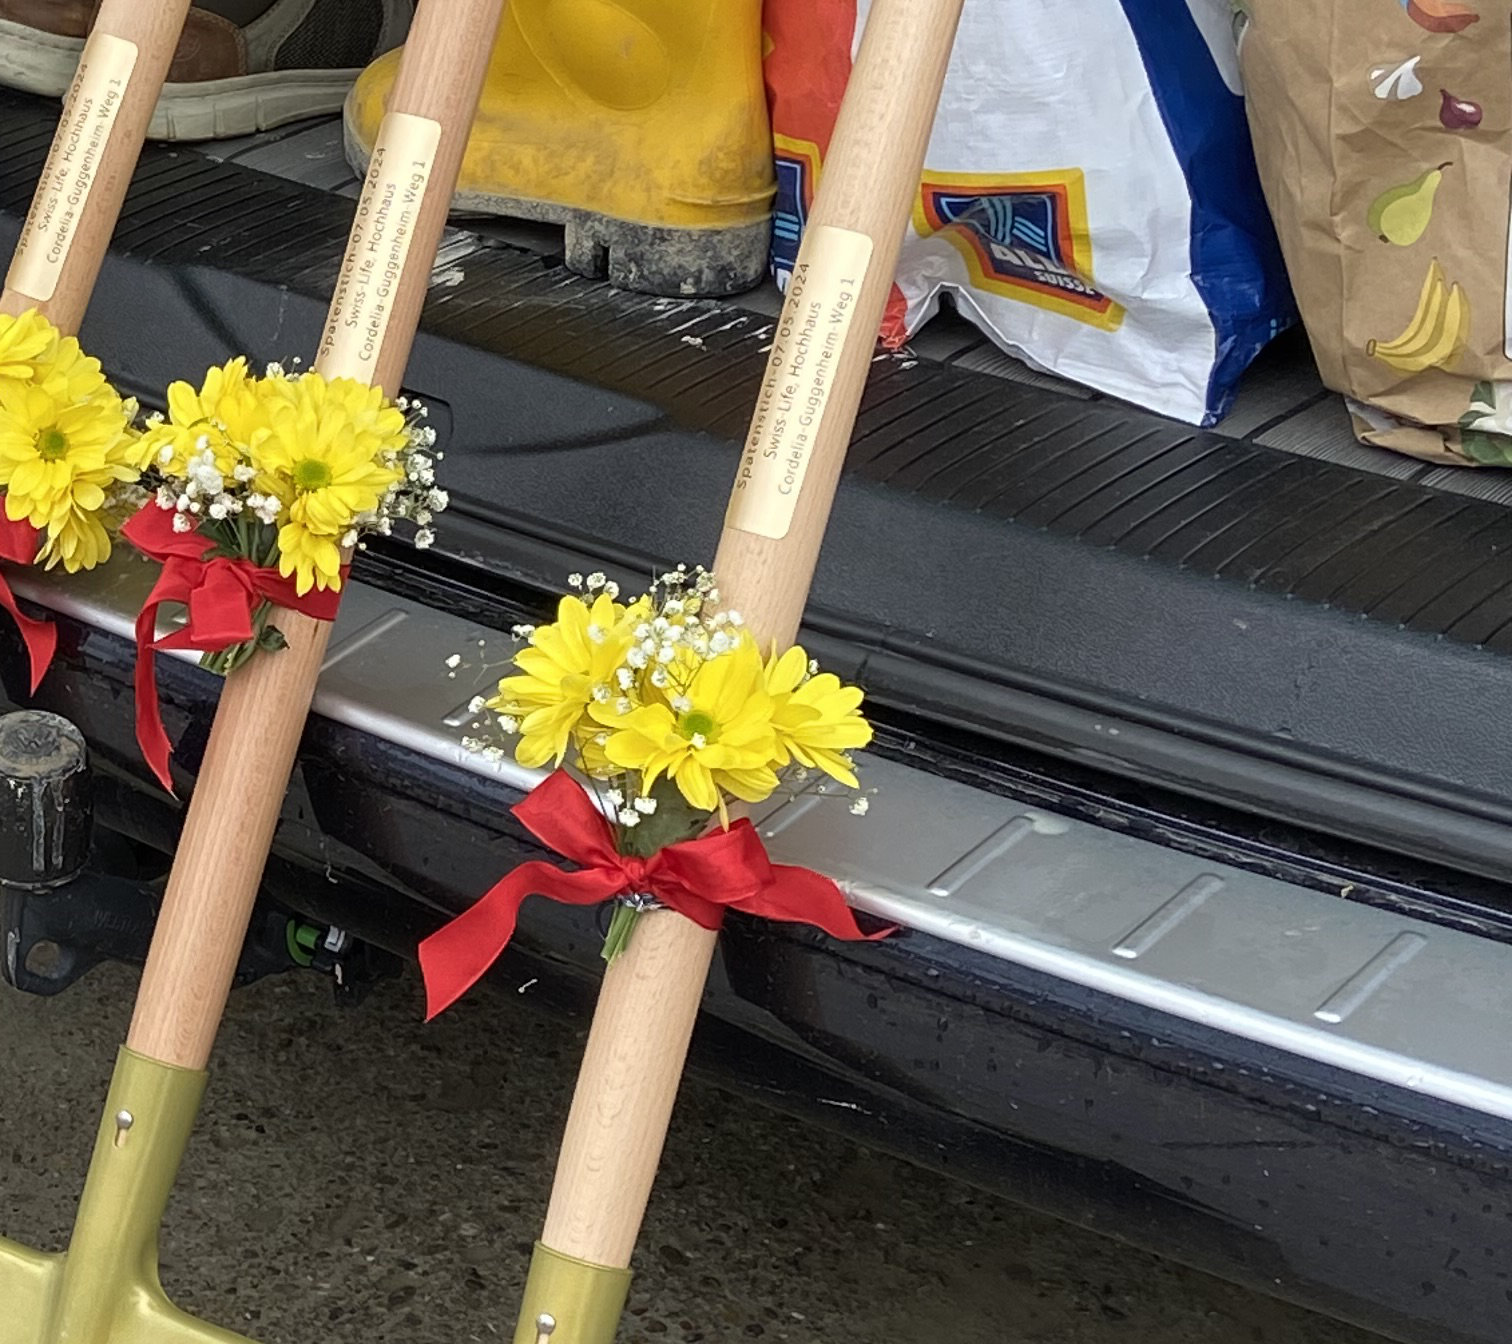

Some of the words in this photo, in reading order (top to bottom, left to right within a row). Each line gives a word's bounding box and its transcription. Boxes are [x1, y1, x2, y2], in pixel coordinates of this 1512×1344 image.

[367, 182, 397, 255] Hochhaus
[789, 300, 823, 378] Hochhaus
[776, 285, 856, 497] Cordelia-Guggenheim-Weg
